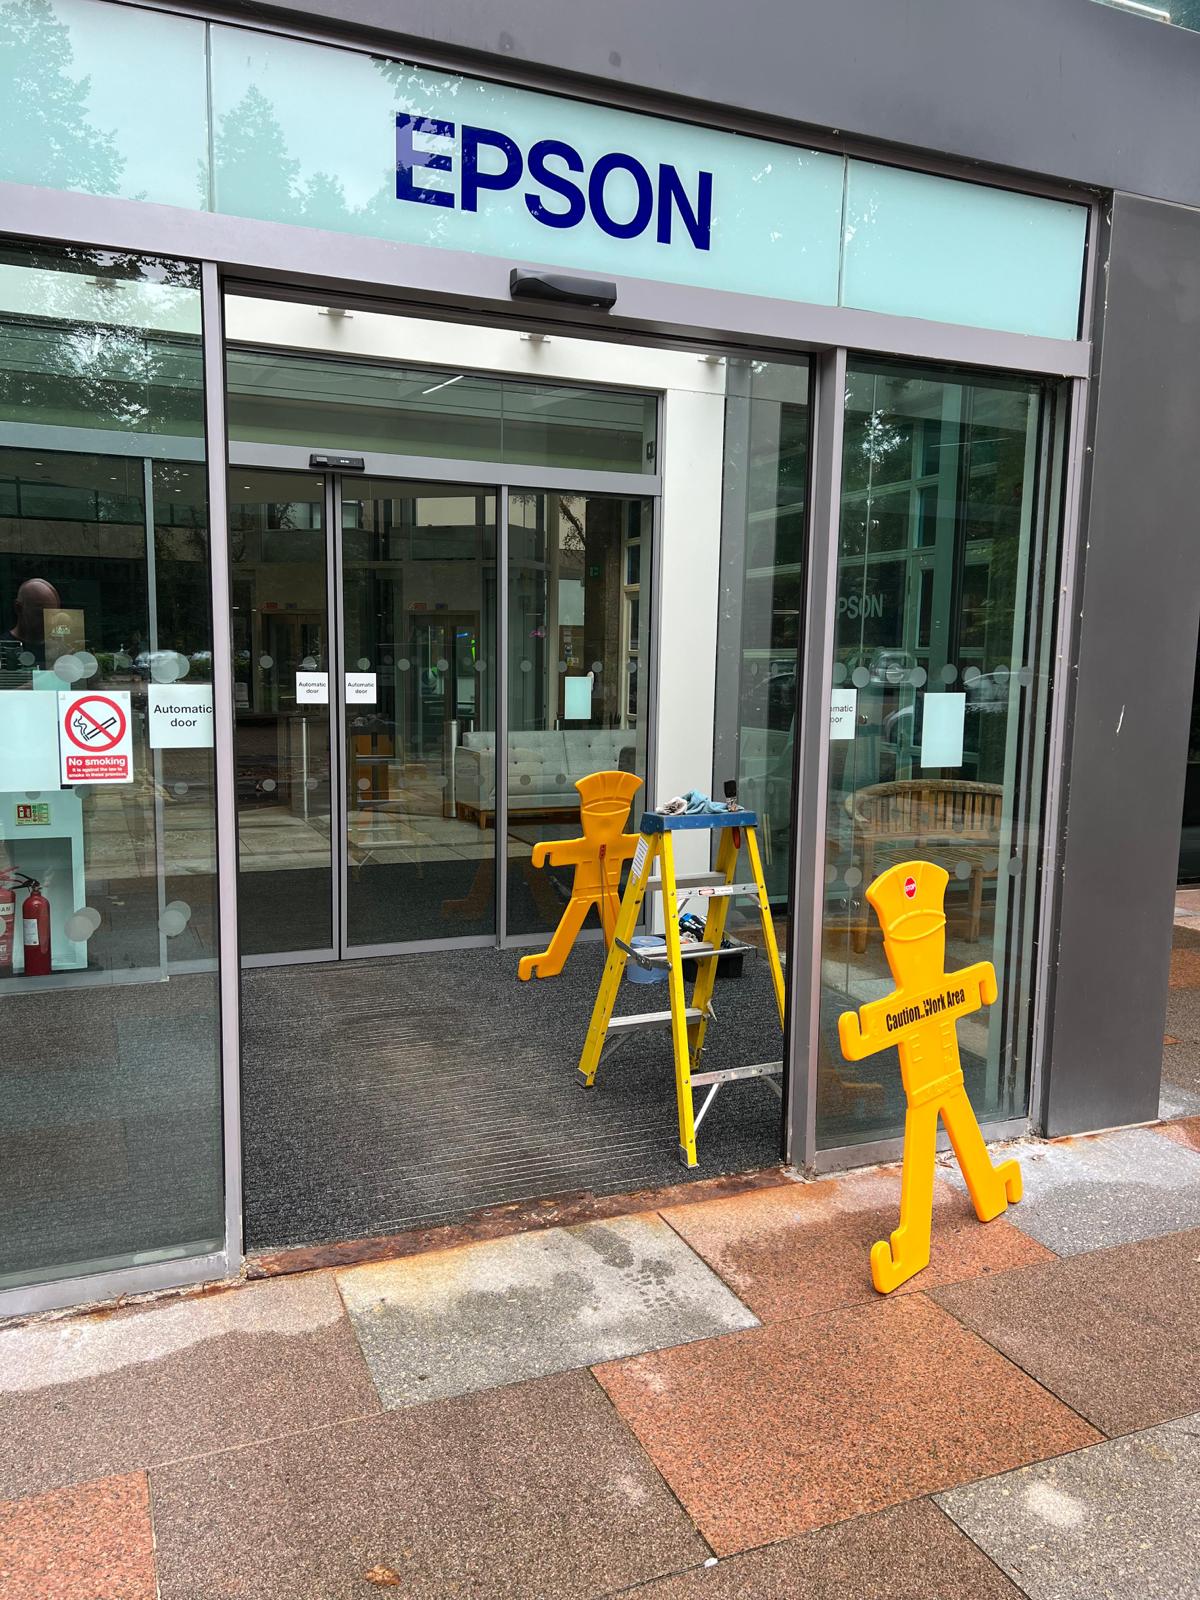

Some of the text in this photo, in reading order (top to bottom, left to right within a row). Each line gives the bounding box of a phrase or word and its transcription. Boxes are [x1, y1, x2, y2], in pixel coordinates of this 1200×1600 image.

[395, 111, 713, 251] EPSON
[837, 593, 883, 619] PSON
[153, 704, 213, 714] Automatic
[170, 718, 197, 727] door
[68, 757, 125, 767] No smoking
[923, 994, 946, 1016] Work
[946, 988, 966, 1008] Area
